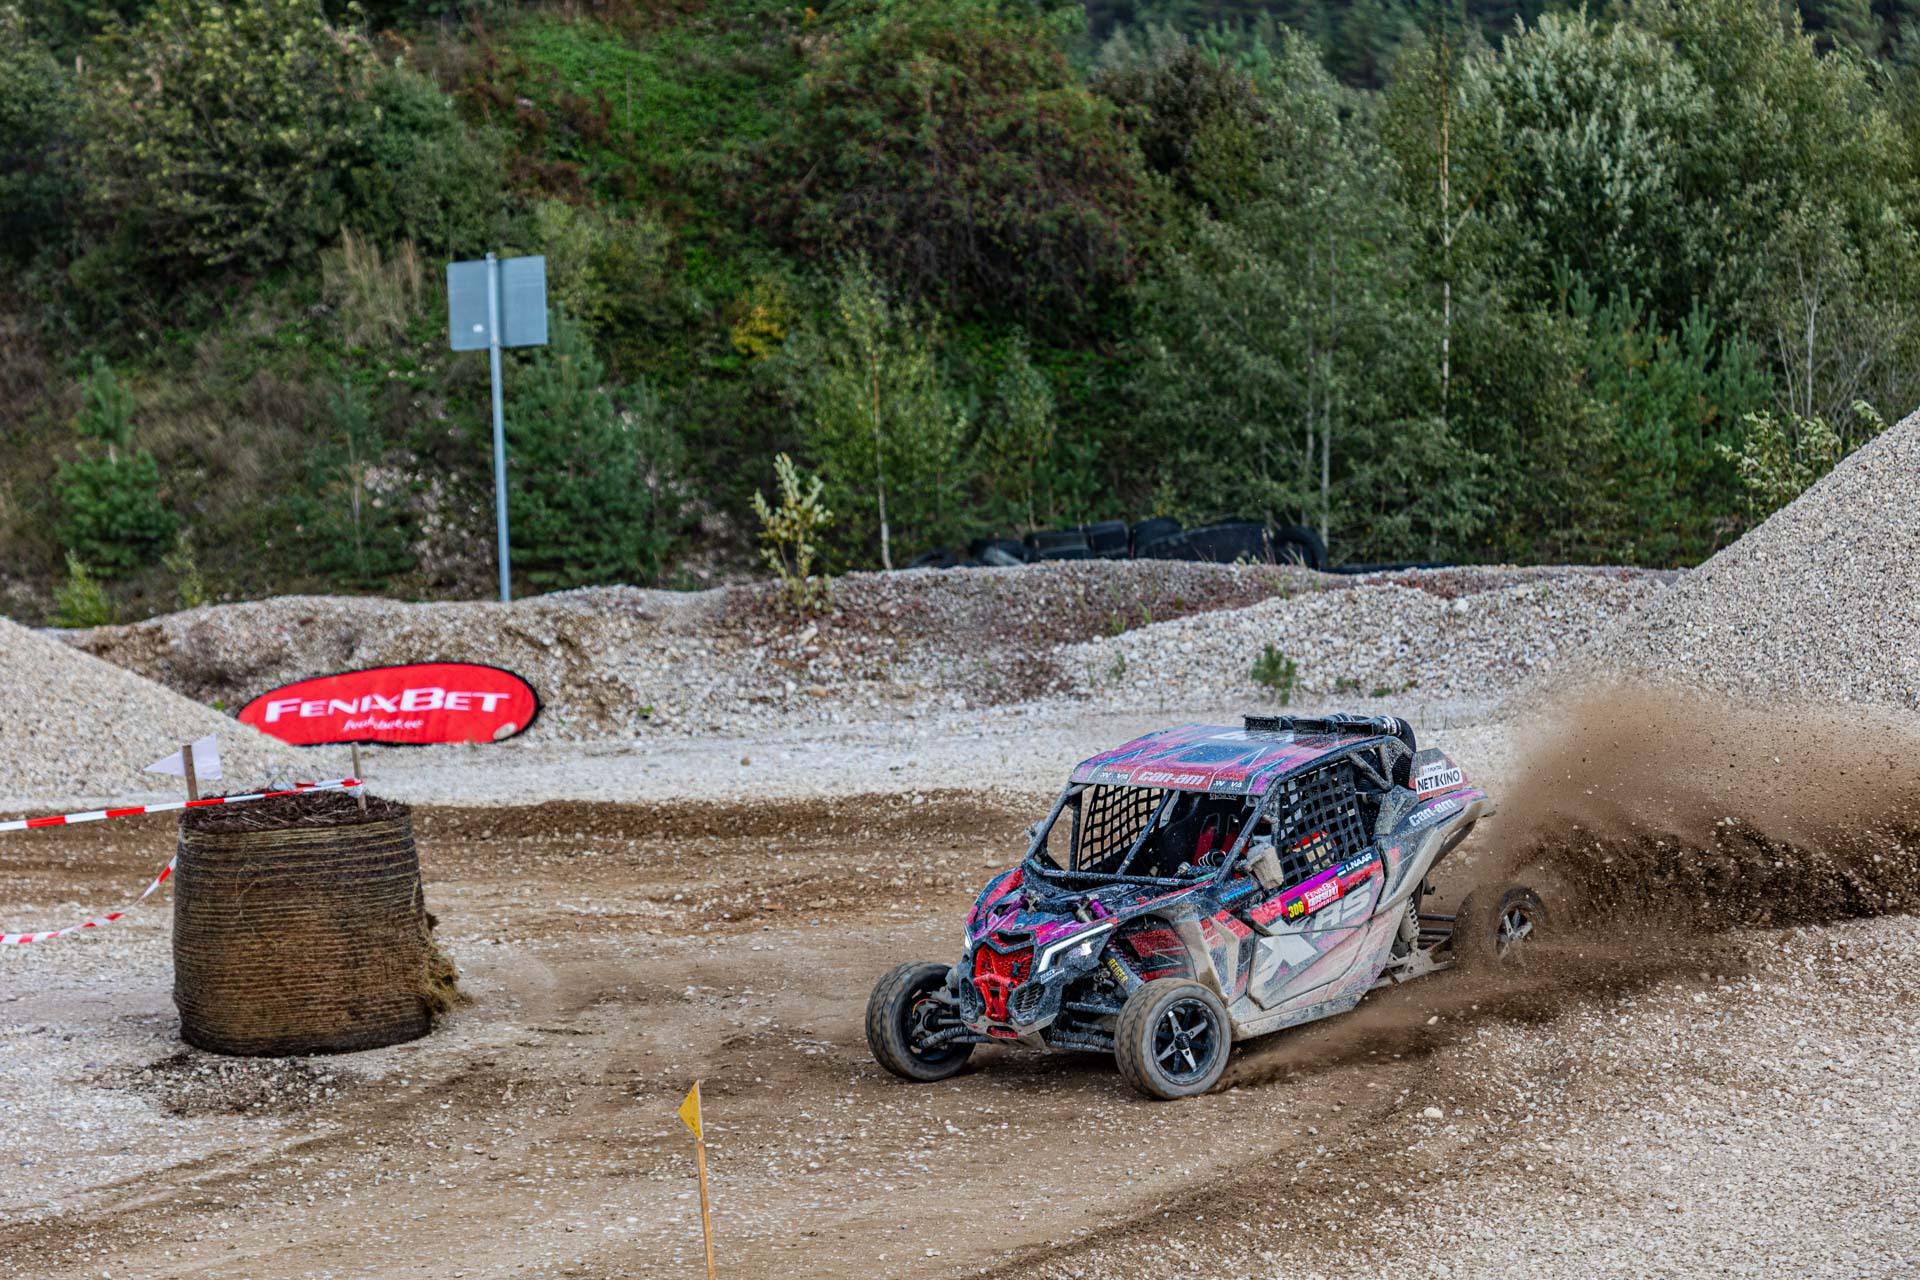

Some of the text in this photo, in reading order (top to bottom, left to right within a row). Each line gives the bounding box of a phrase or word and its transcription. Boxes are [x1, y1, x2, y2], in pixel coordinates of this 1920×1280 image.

[1138, 770, 1206, 786] can-am
[1408, 798, 1456, 827] can-am
[1287, 900, 1305, 919] 306
